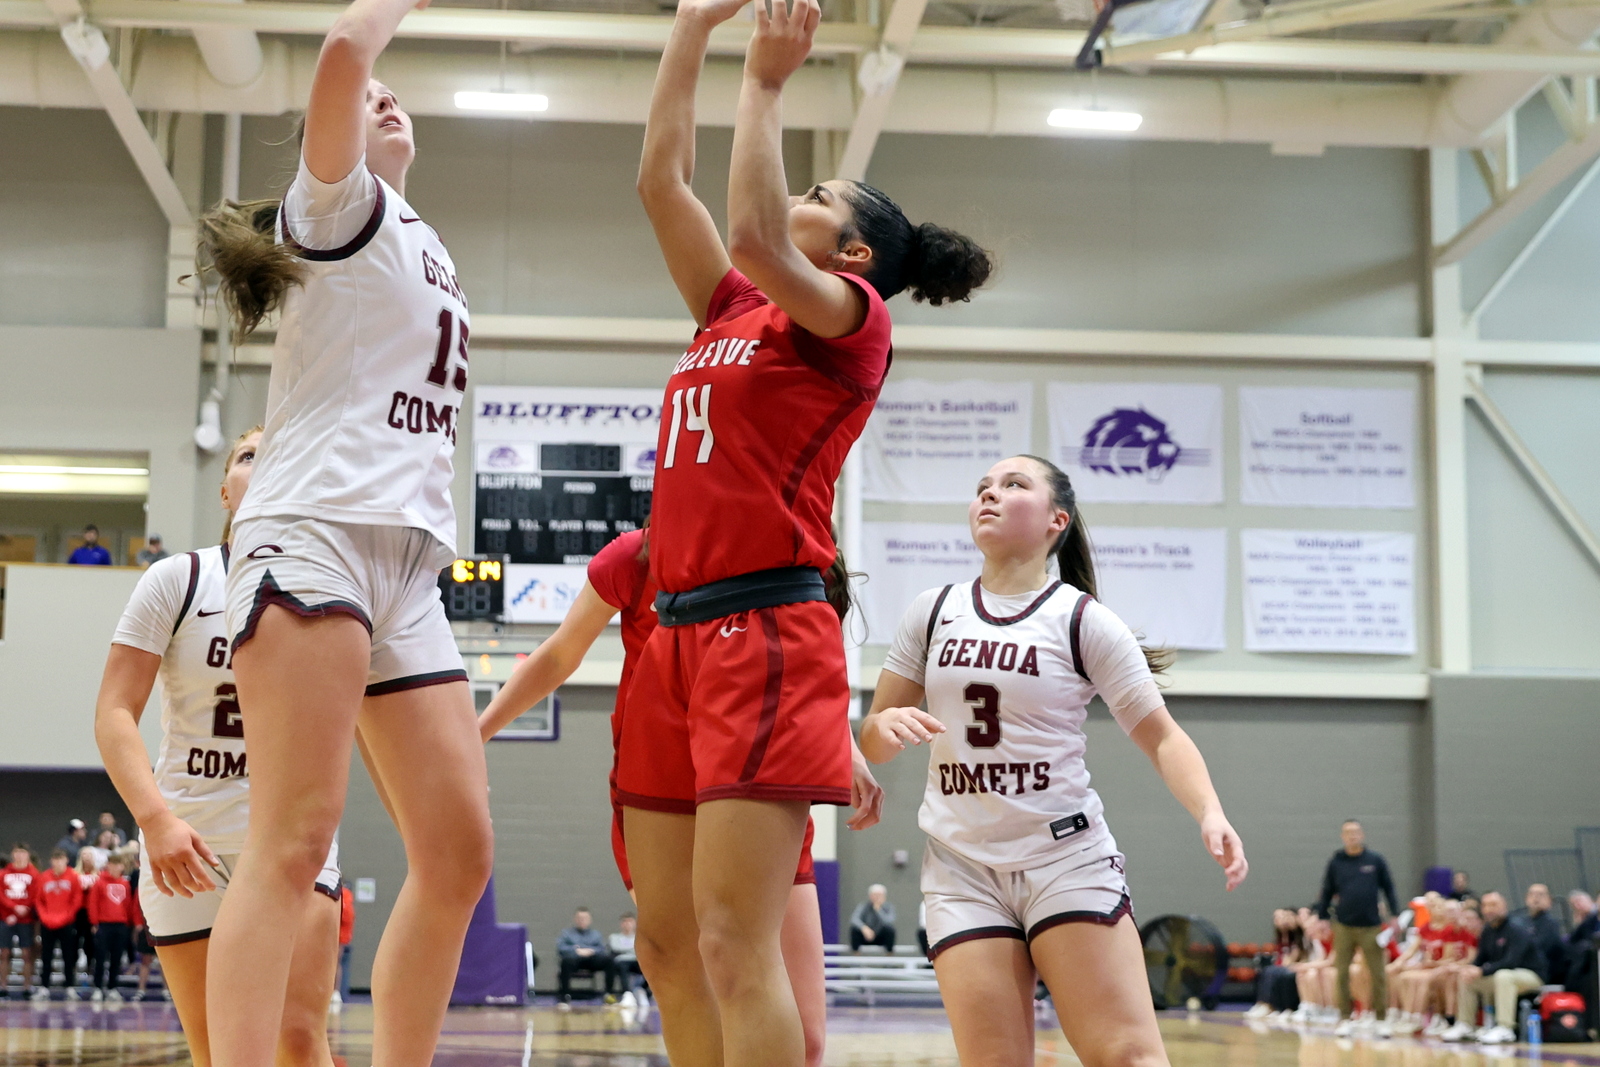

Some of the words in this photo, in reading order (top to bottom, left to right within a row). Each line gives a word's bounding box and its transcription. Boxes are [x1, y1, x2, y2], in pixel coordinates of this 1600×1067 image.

[479, 401, 662, 420] BLUFFTO
[941, 400, 1016, 413] Basketball
[663, 383, 714, 469] 14
[478, 474, 542, 491] BLUFFTON
[481, 518, 512, 531] FOULS
[549, 519, 584, 532] PLAYER
[1153, 542, 1191, 555] Track
[452, 559, 501, 583] 6:14
[938, 638, 1040, 677] GENOA
[963, 681, 1002, 750] 3
[187, 747, 250, 780] COM
[939, 761, 1051, 796] COMETS
[1077, 818, 1084, 826] S
